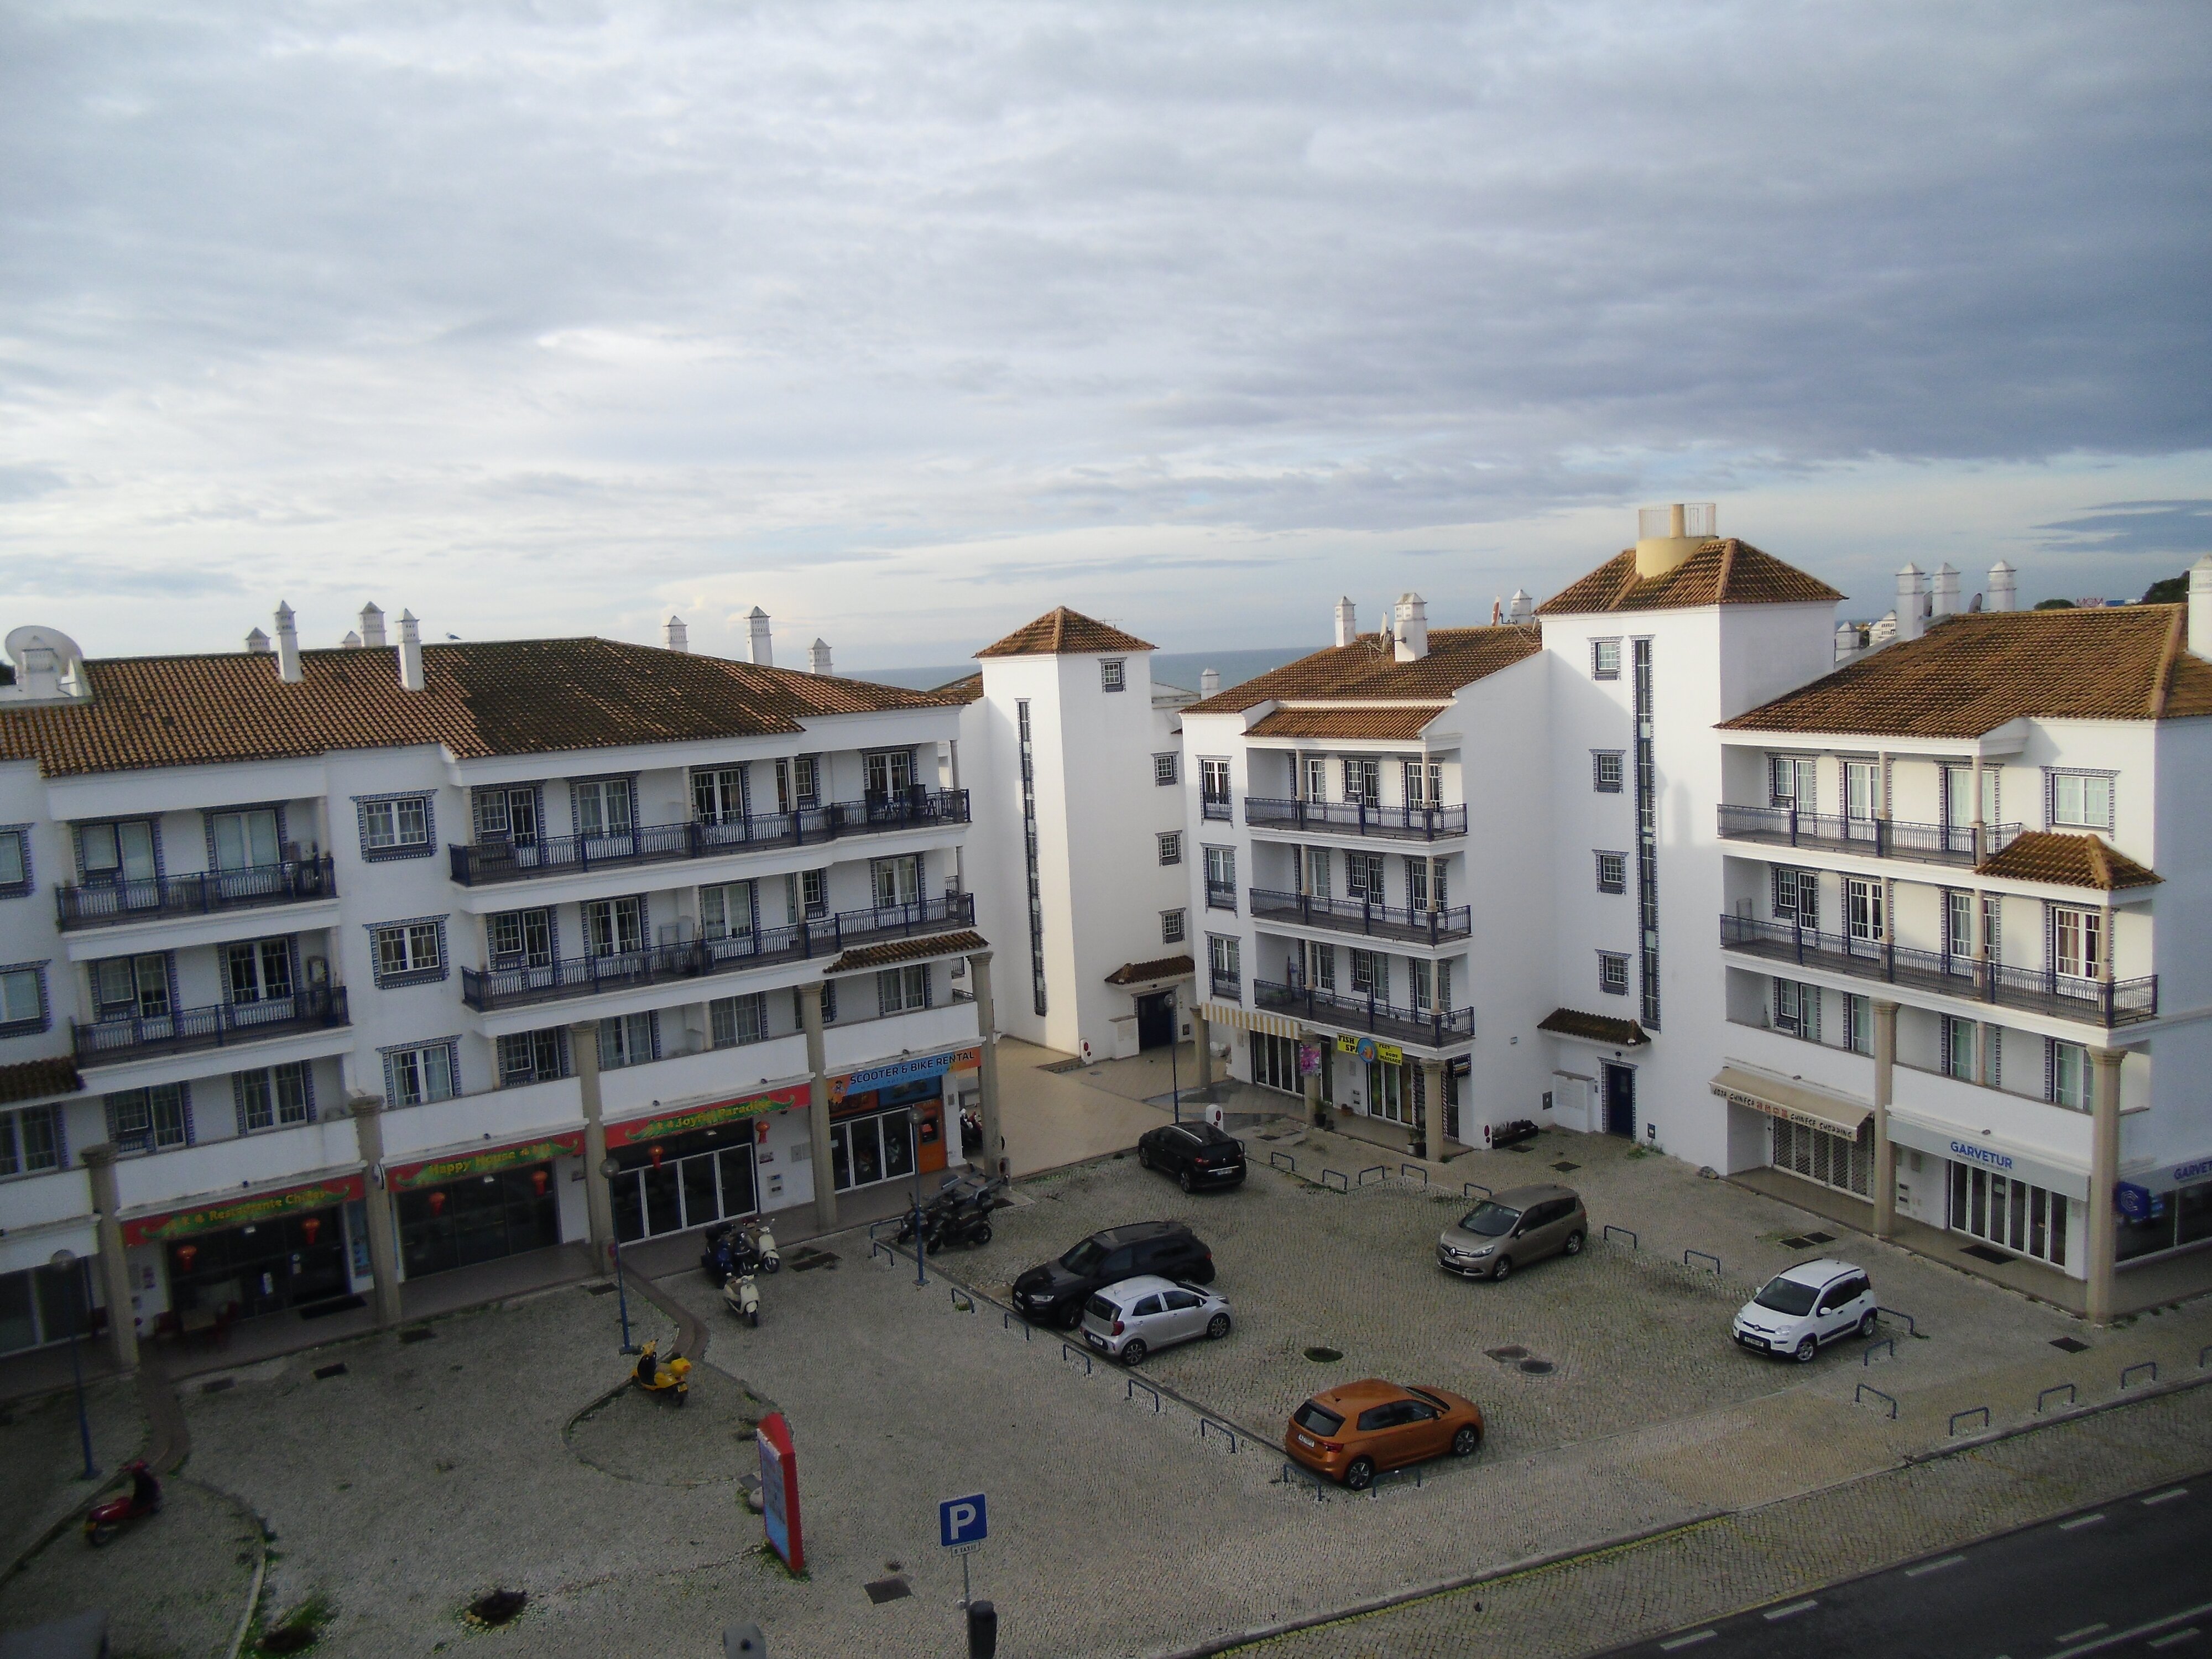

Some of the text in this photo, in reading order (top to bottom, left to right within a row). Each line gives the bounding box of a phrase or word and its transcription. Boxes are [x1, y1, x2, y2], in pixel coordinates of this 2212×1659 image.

[1338, 1035, 1354, 1044] FISH
[850, 1051, 975, 1085] SCOOTER & BIKE RENTAL
[1380, 1055, 1401, 1064] MASSAGE
[1714, 1088, 1727, 1097] LOJA
[1791, 1113, 1815, 1126] CHINESE
[1819, 1122, 1852, 1138] SHOPPING
[429, 1151, 515, 1176] Happy House
[1950, 1141, 2012, 1169] GARVETUR
[950, 1503, 977, 1540] P
